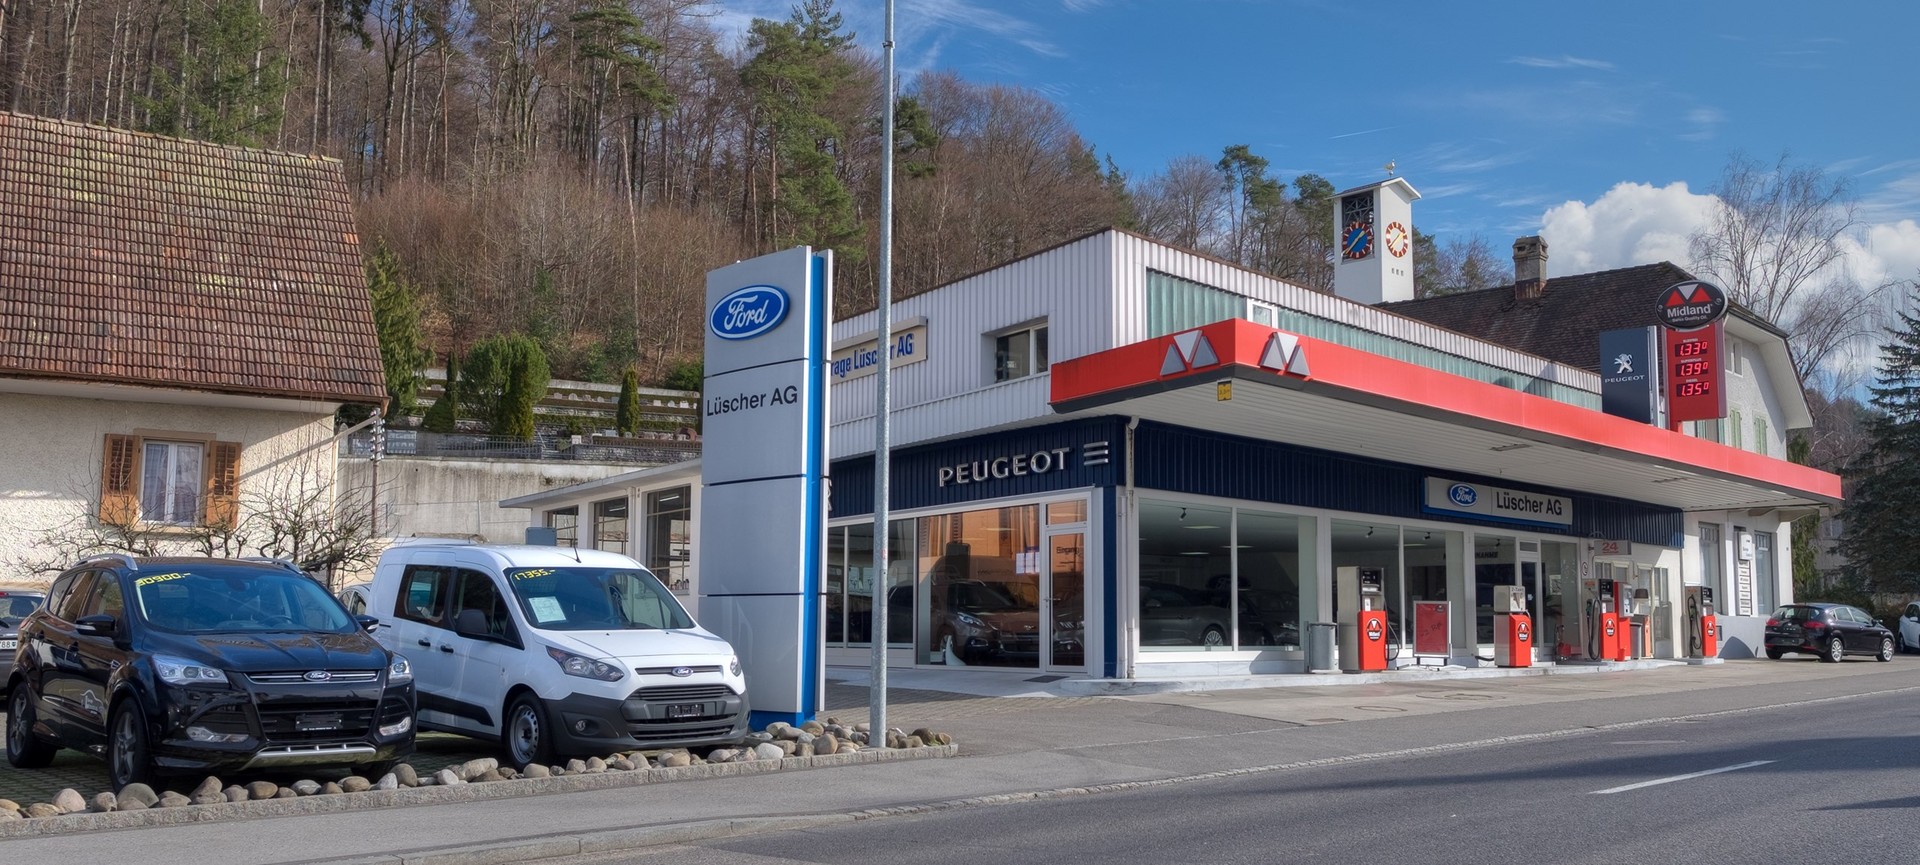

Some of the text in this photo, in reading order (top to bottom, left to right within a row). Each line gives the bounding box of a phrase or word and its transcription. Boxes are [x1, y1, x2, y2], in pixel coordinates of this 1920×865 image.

[724, 295, 769, 330] Ford
[1667, 304, 1711, 318] Midland
[831, 333, 914, 378] rage Lüscr AG
[1604, 375, 1645, 383] PEUGEOT
[707, 385, 798, 416] Lüscher AG
[939, 447, 1070, 487] PEUGEOT
[1456, 486, 1562, 516] Ford Lüscher AG
[1602, 542, 1618, 551] 24
[0, 640, 11, 648] 88
